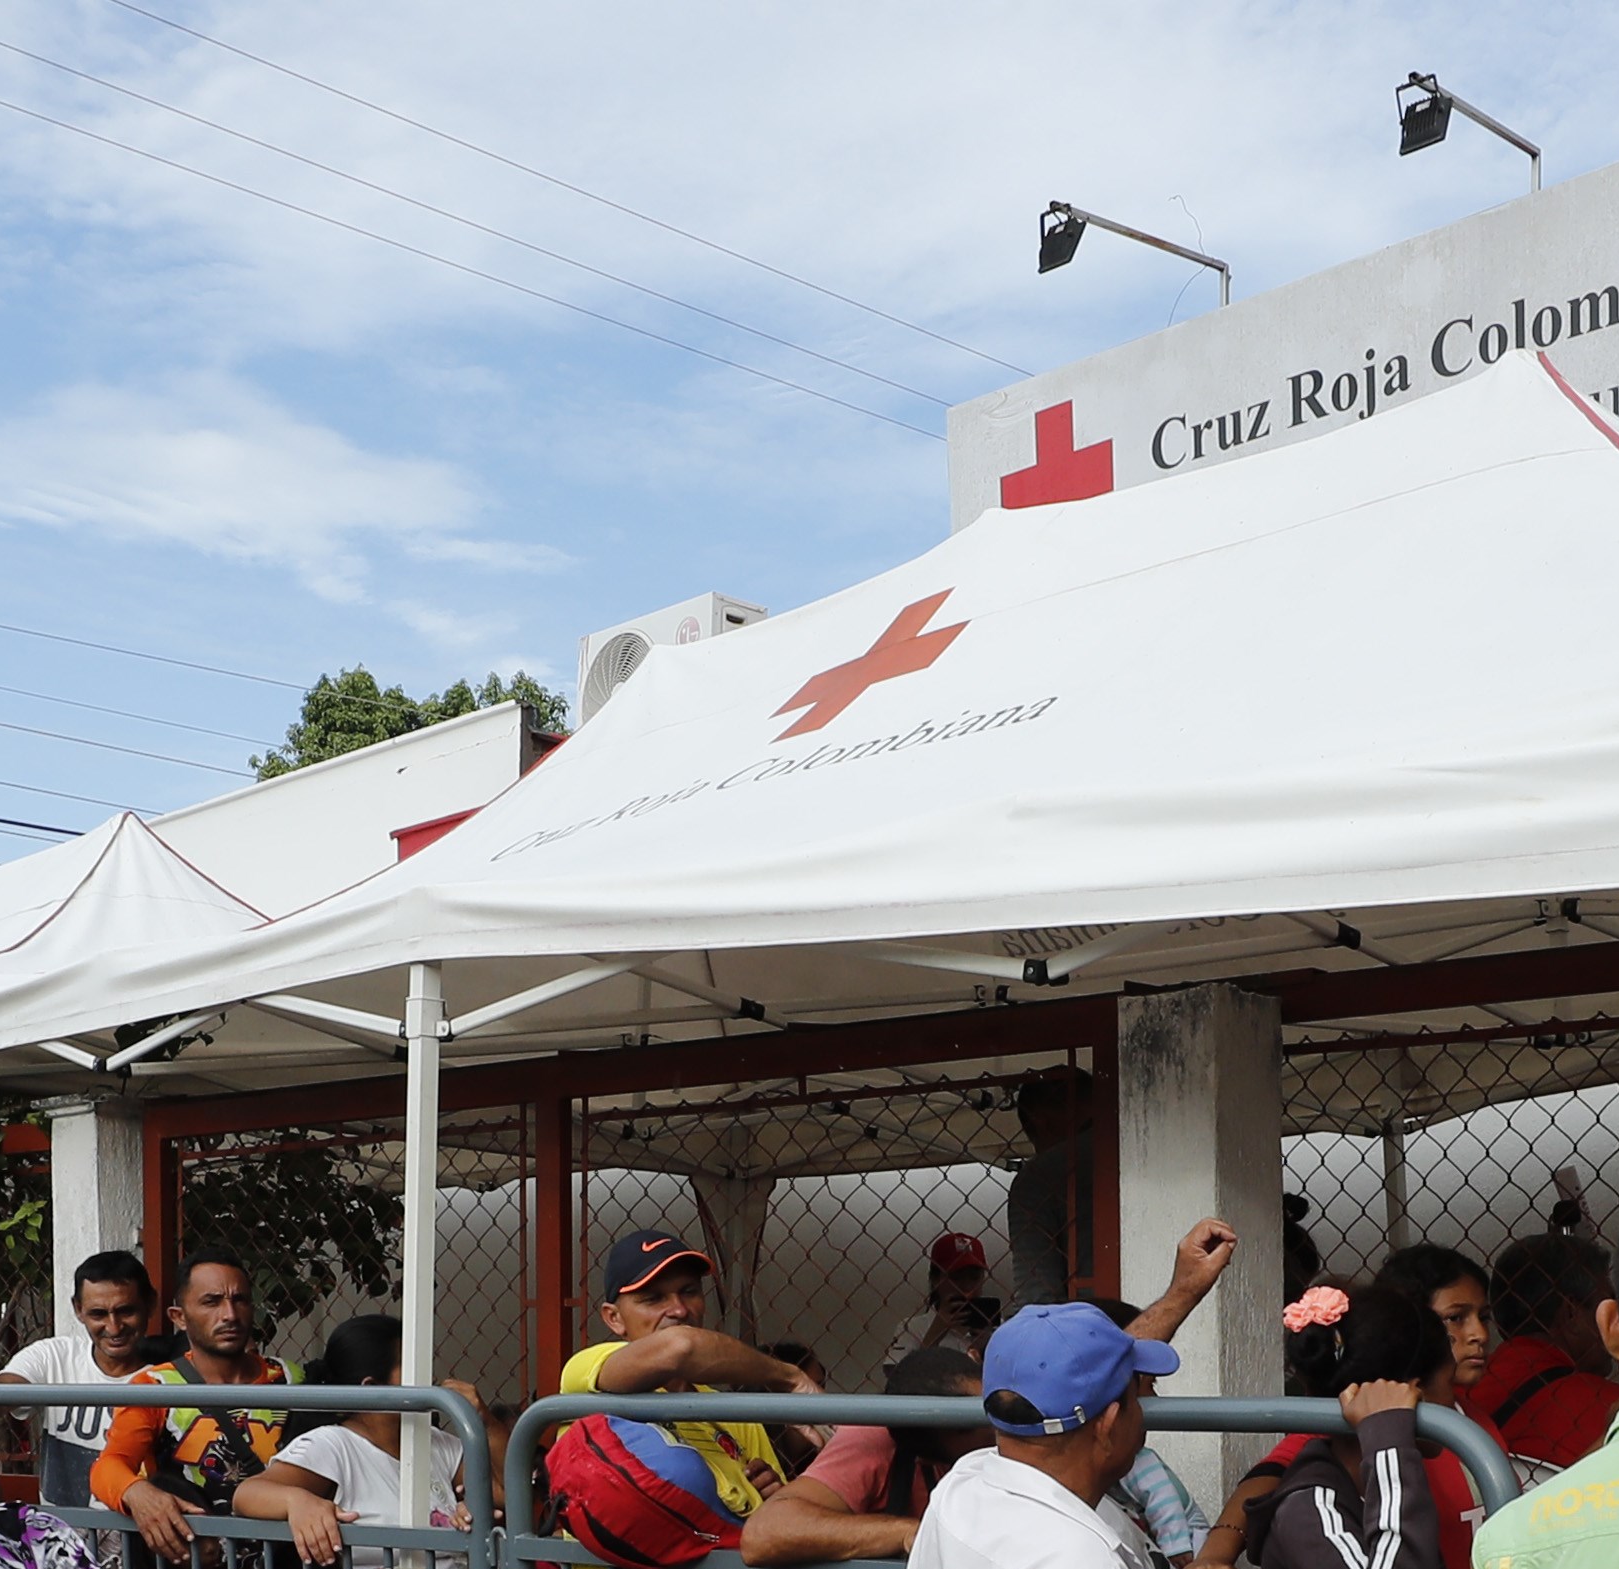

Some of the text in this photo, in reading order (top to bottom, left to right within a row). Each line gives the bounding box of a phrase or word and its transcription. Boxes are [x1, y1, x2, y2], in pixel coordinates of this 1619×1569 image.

[1151, 398, 1272, 471] Cruz
[1286, 347, 1410, 428] Roja
[716, 696, 1059, 791] Colombiana
